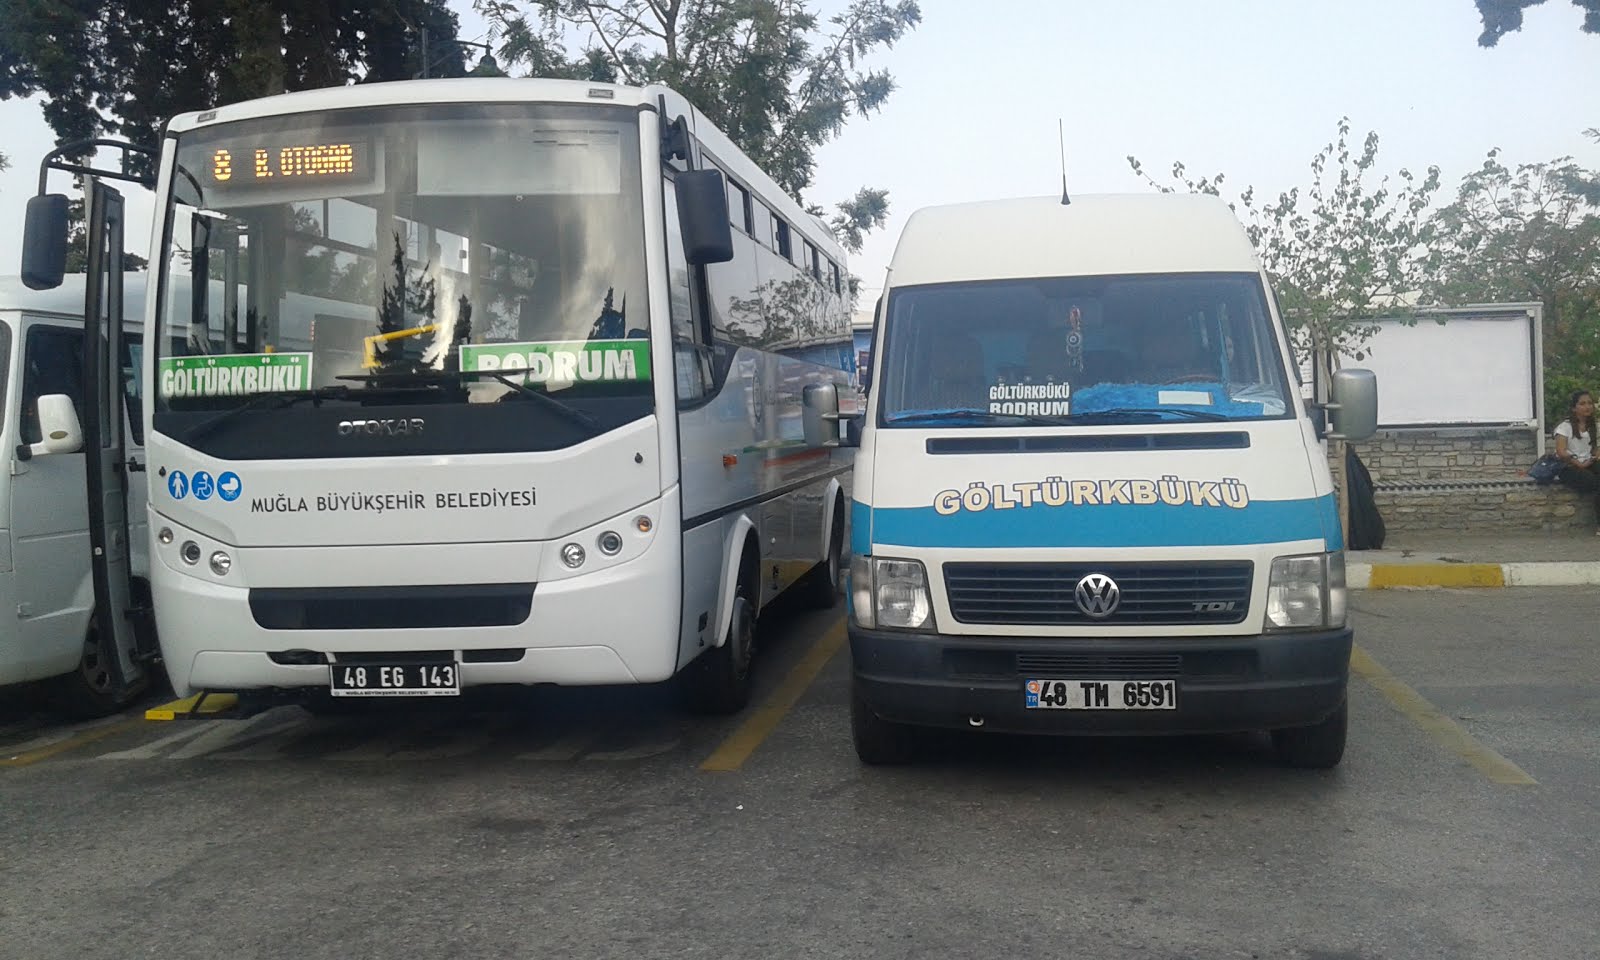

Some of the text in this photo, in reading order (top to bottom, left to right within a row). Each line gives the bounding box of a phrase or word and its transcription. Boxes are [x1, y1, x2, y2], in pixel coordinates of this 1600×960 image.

[214, 144, 353, 181] 8 B. OTOGAR
[161, 356, 302, 398] GÖLTÜRKBÜKÜ
[989, 382, 1070, 400] GÖLTÜRKBÜKÜ
[338, 418, 425, 435] OTOKAR
[251, 487, 537, 513] MUĞLA BÜYÜKŞEHİR BELEDİYESİ
[933, 475, 1250, 516] GÖLTÜRKBÜKÜ
[1191, 601, 1236, 612] TDI
[344, 666, 454, 687] 48 EG 143
[1027, 695, 1037, 703] TR
[1040, 681, 1174, 707] 48 TM 6591
